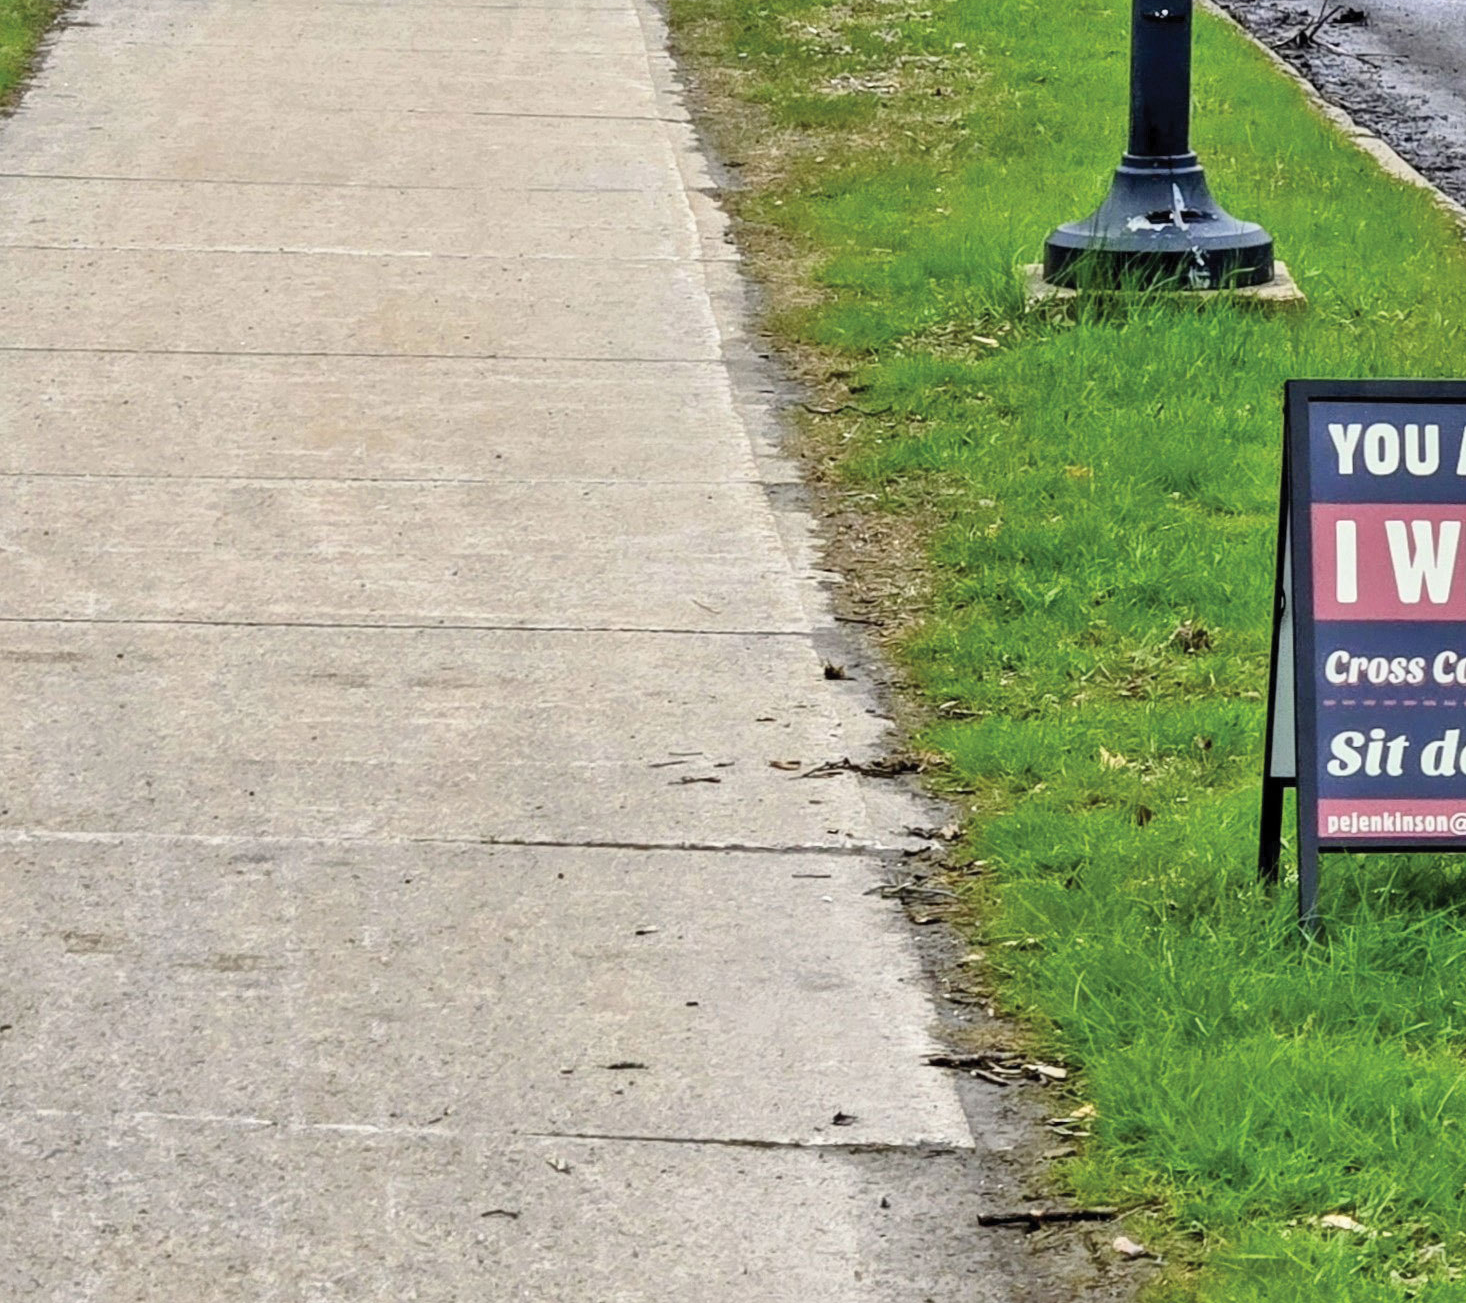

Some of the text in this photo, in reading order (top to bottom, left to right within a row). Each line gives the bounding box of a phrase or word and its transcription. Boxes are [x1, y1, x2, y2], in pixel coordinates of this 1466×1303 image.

[1327, 423, 1440, 476] YOU
[1335, 519, 1358, 604] I
[1324, 650, 1426, 685] Cross
[1326, 728, 1410, 777] Sit
